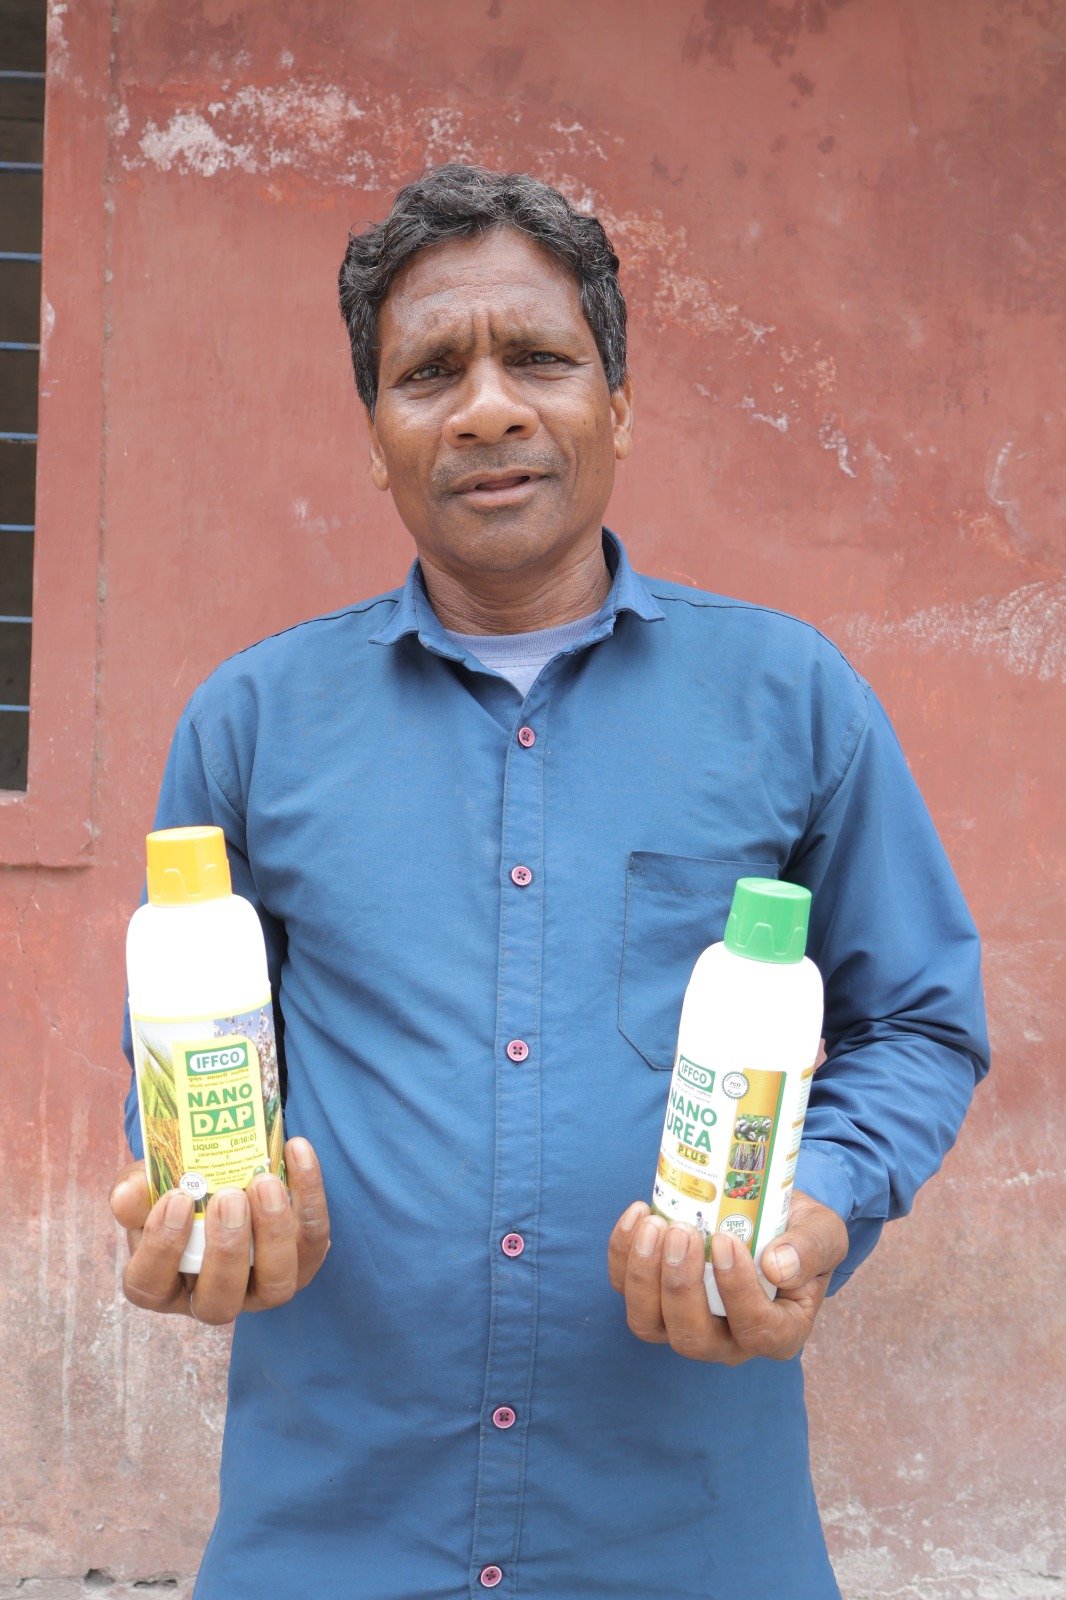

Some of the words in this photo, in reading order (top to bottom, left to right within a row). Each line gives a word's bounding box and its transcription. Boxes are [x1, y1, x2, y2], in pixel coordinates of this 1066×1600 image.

[196, 1051, 240, 1069] IFFCO
[681, 1062, 707, 1084] IFFCO
[187, 1083, 252, 1108] NANO
[670, 1087, 717, 1127] NANO
[193, 1105, 252, 1134] DAP
[666, 1108, 712, 1152] UREA
[192, 1142, 219, 1151] LIQUID
[677, 1144, 707, 1164] PLUS
